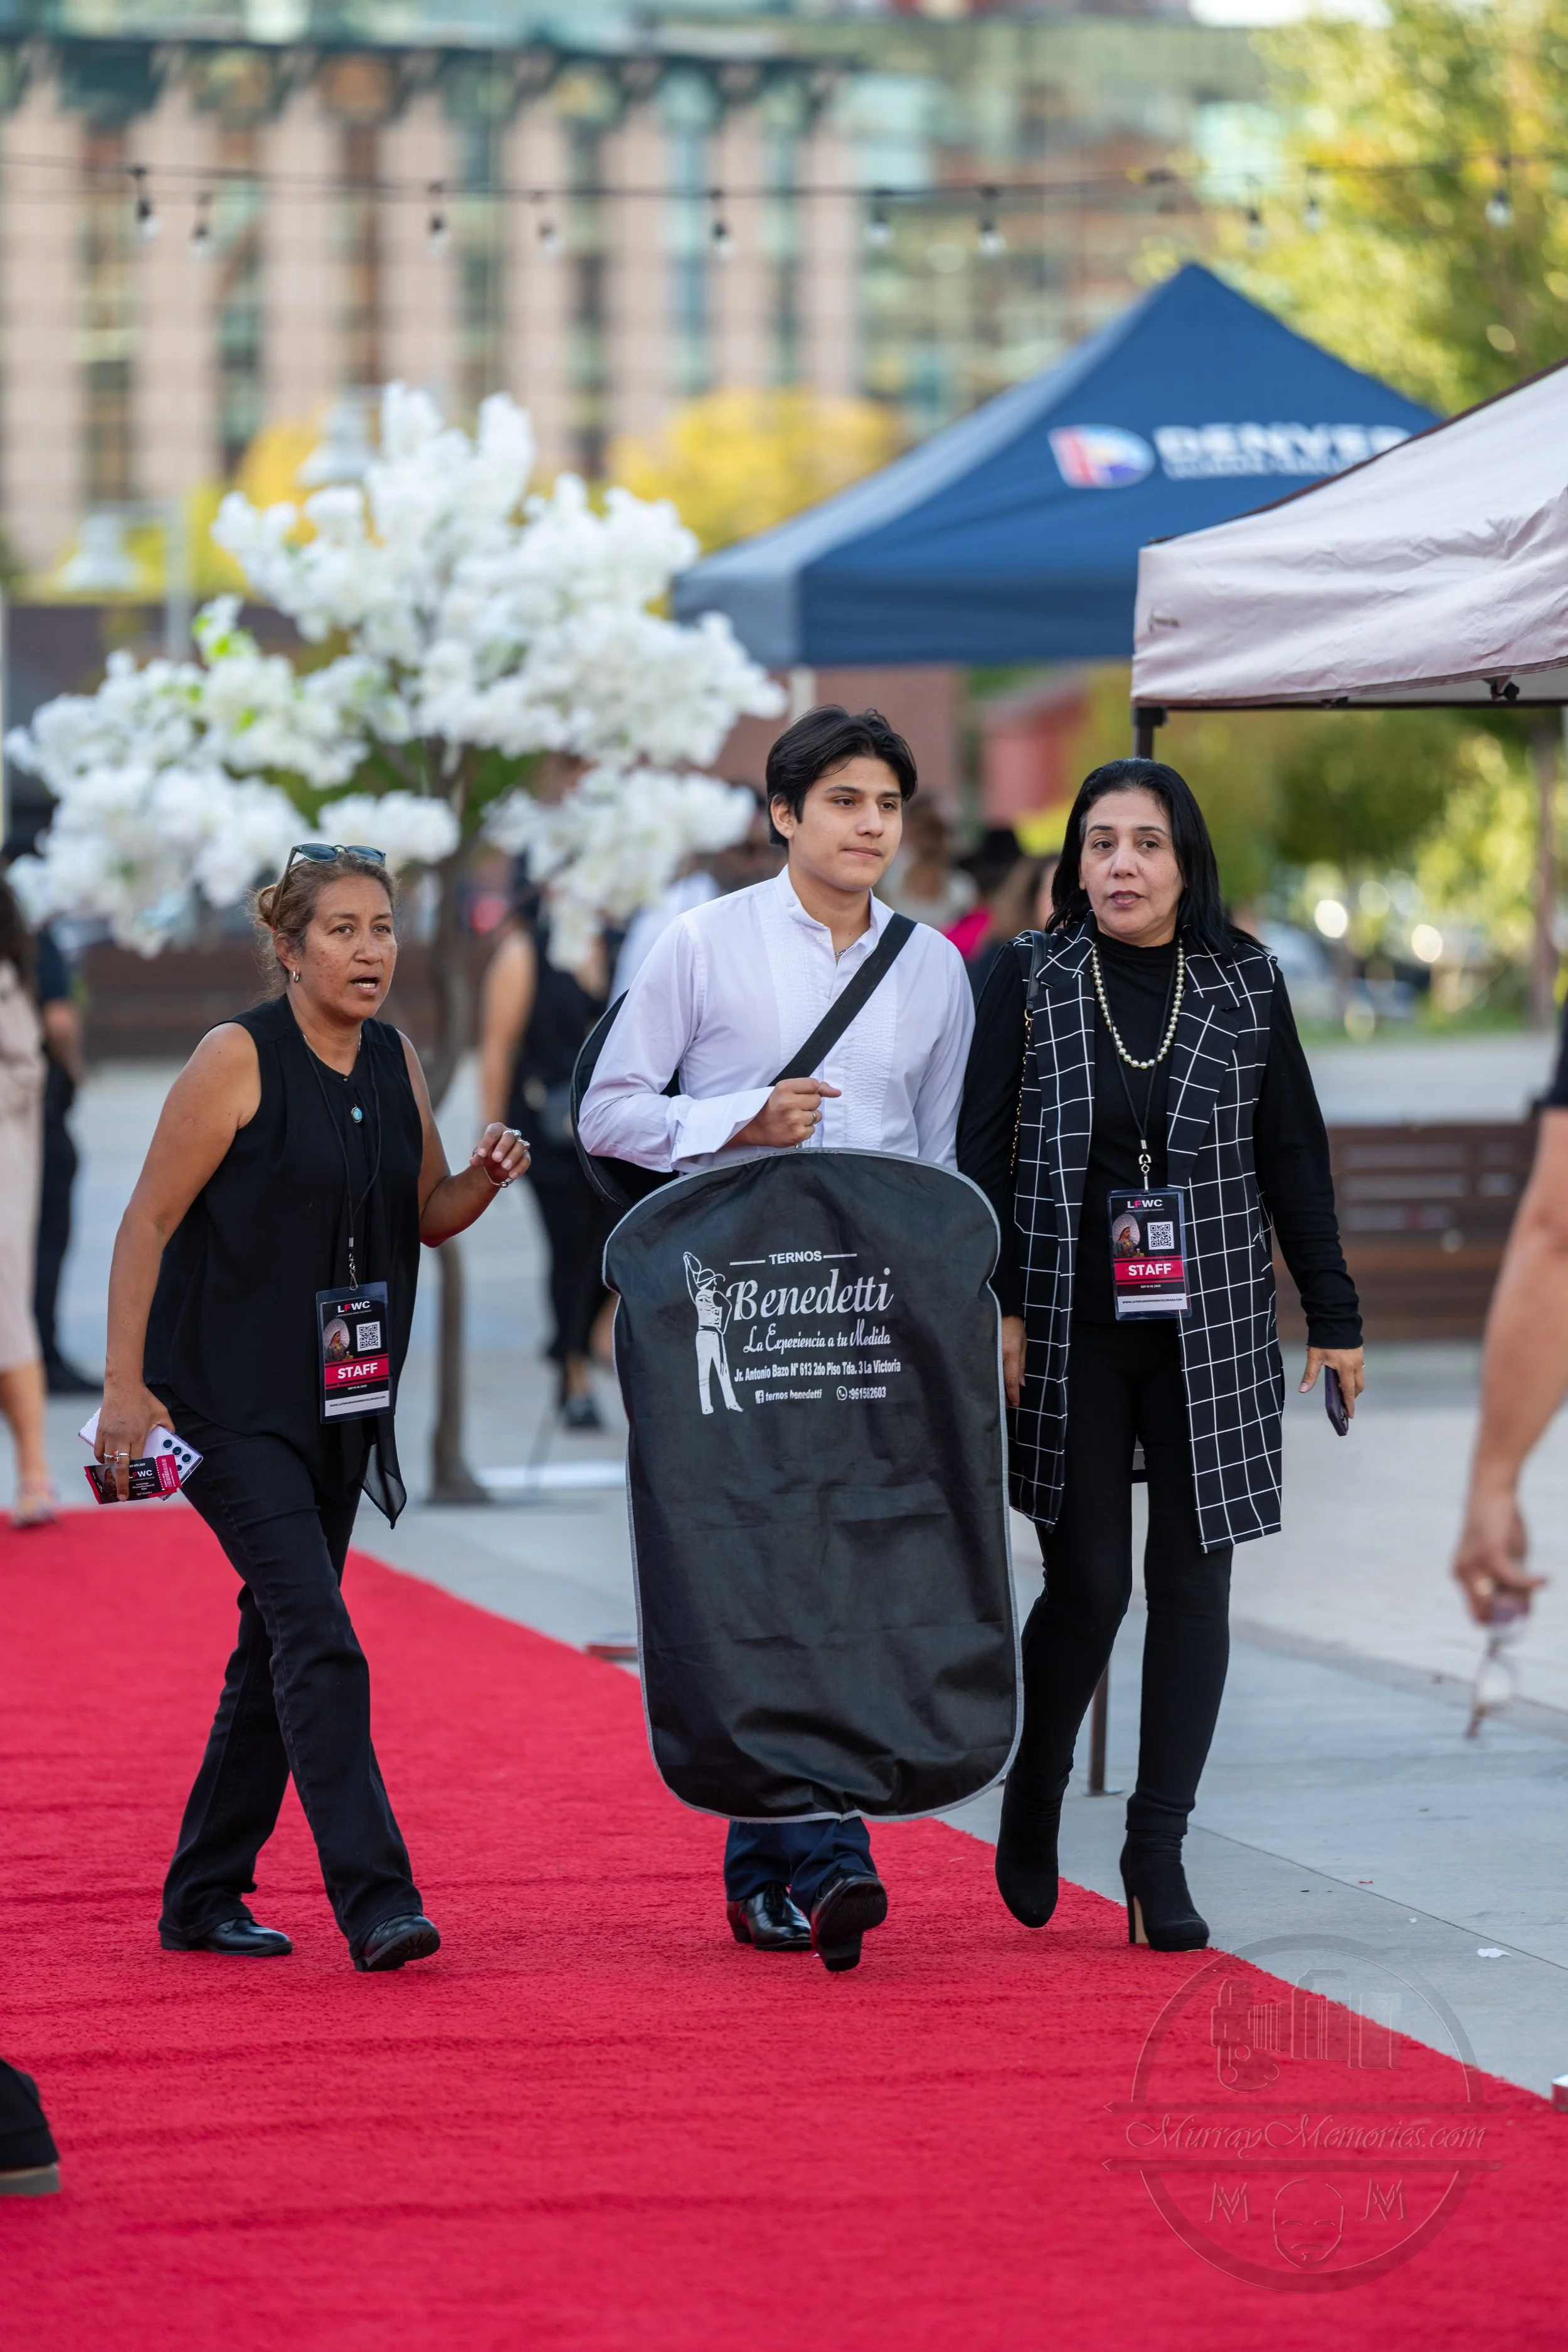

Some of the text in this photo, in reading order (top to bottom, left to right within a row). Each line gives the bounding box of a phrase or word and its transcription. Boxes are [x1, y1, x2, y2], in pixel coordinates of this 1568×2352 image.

[1127, 1199, 1163, 1209] LFWC
[769, 1251, 822, 1265] TERNOS
[1128, 1263, 1172, 1276] STAFF
[726, 1268, 894, 1321] Benedetti
[337, 1301, 371, 1313] LFWC
[743, 1318, 891, 1355] La Experiencia a tu Medida
[337, 1362, 378, 1379] STAFF
[734, 1369, 744, 1382] Jr.
[744, 1364, 770, 1381] Antonio
[772, 1364, 789, 1377] Bazo
[800, 1362, 812, 1376] 613
[813, 1362, 825, 1376] 2do
[827, 1361, 841, 1375] Piso
[842, 1361, 857, 1375] Tda.
[858, 1360, 863, 1373] 3
[864, 1360, 872, 1373] La
[873, 1359, 901, 1373] Victoria
[765, 1391, 788, 1402] ternos
[790, 1389, 822, 1400] benedetti
